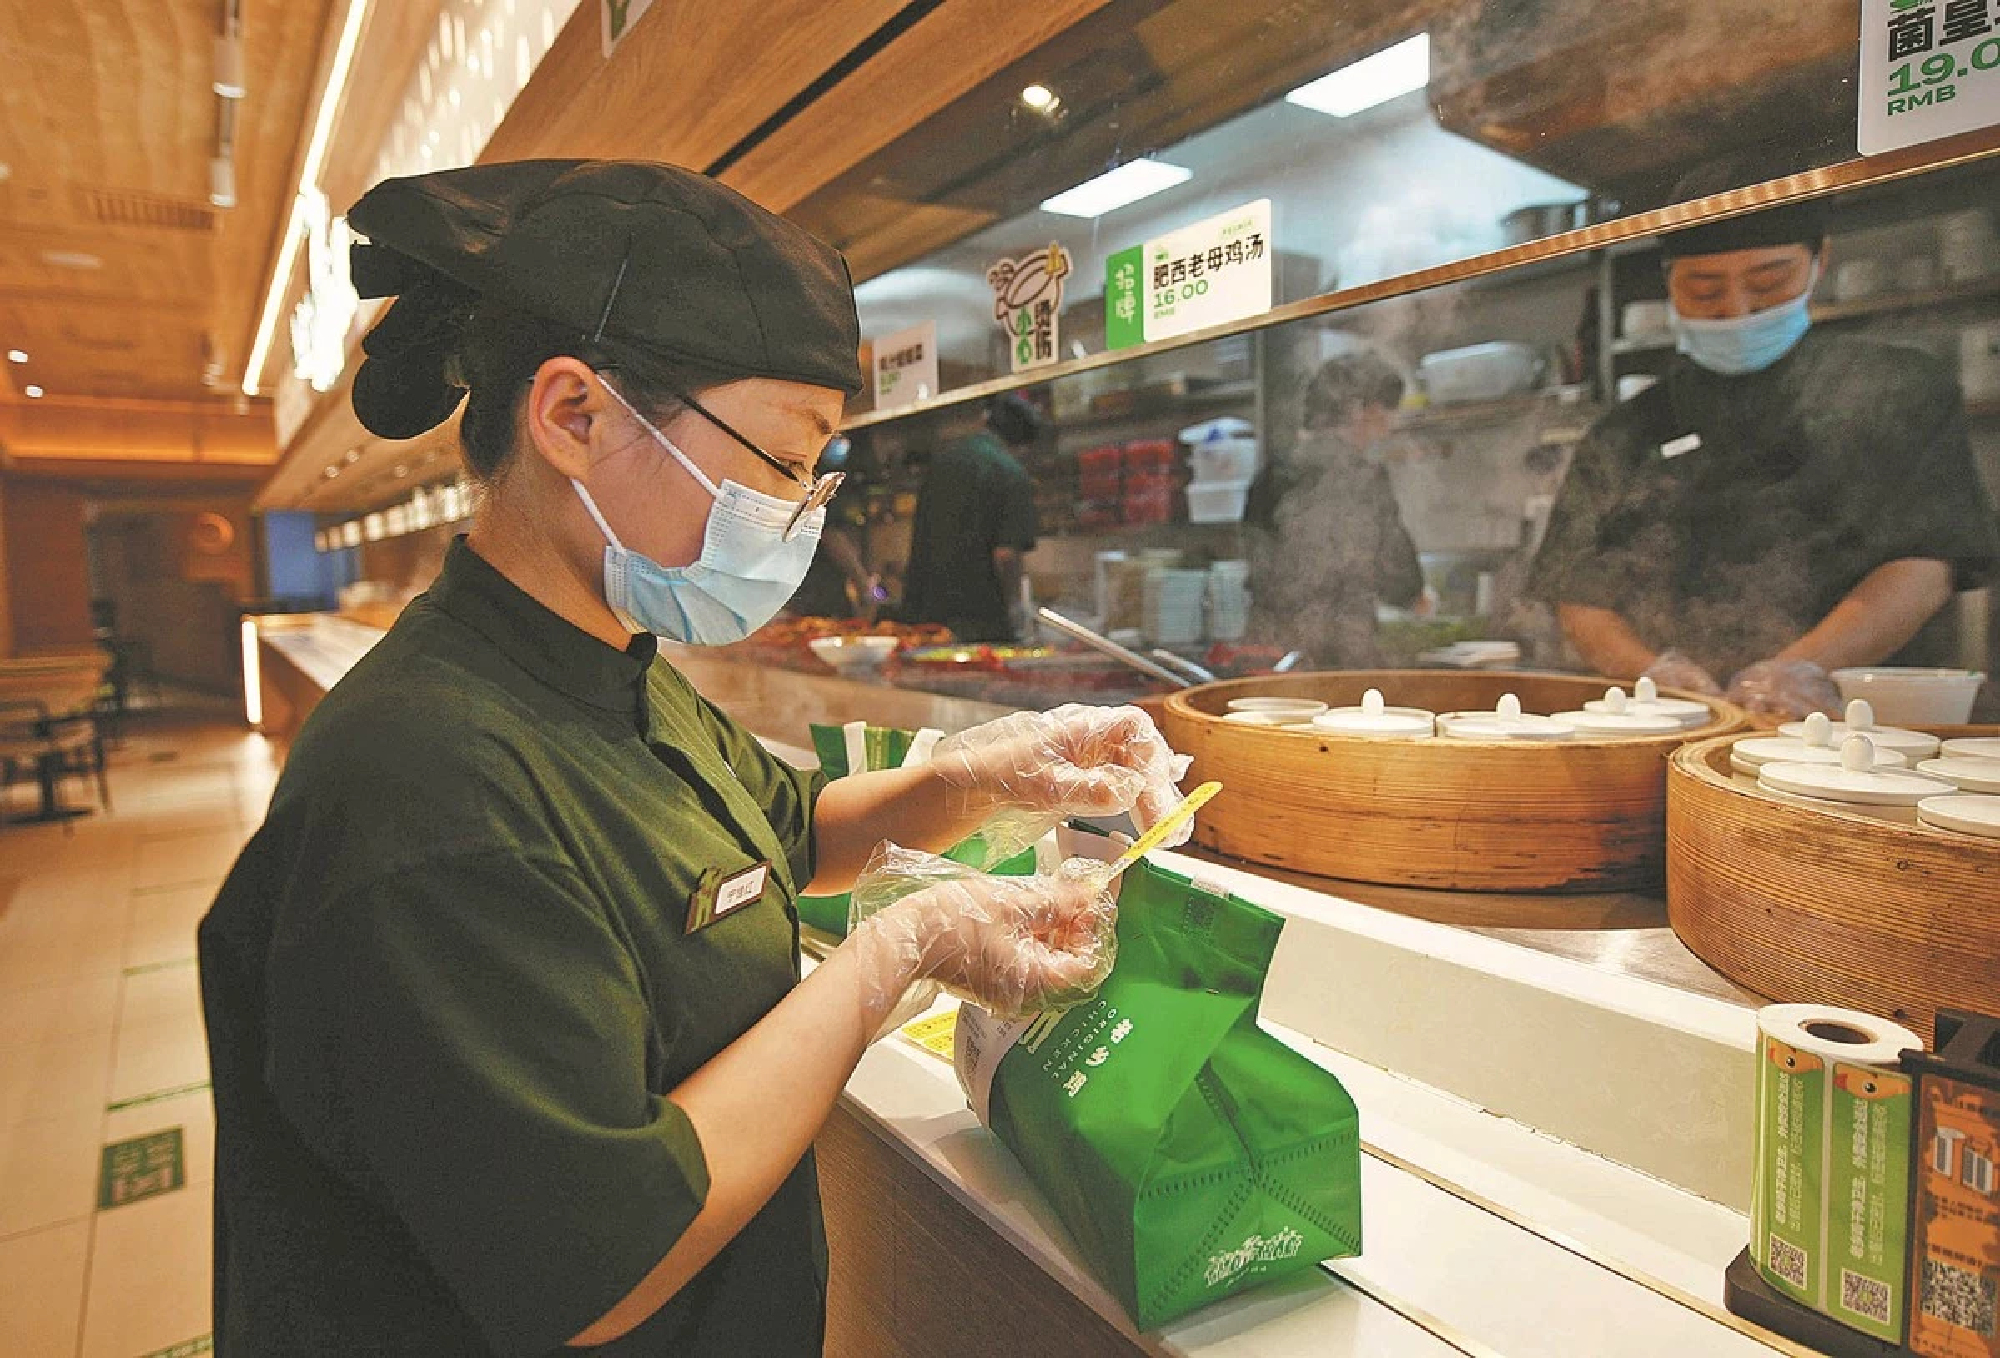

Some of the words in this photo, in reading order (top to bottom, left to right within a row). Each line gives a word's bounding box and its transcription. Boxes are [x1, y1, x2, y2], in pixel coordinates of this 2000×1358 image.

[1887, 0, 2000, 62] 菌皇
[1887, 84, 1956, 116] RMB
[1153, 233, 1264, 290] 肥西老母鸡汤
[1153, 279, 1209, 308] 16.00
[1042, 1000, 1107, 1071] CHICKEN
[1052, 1008, 1117, 1079] ORIGINAL
